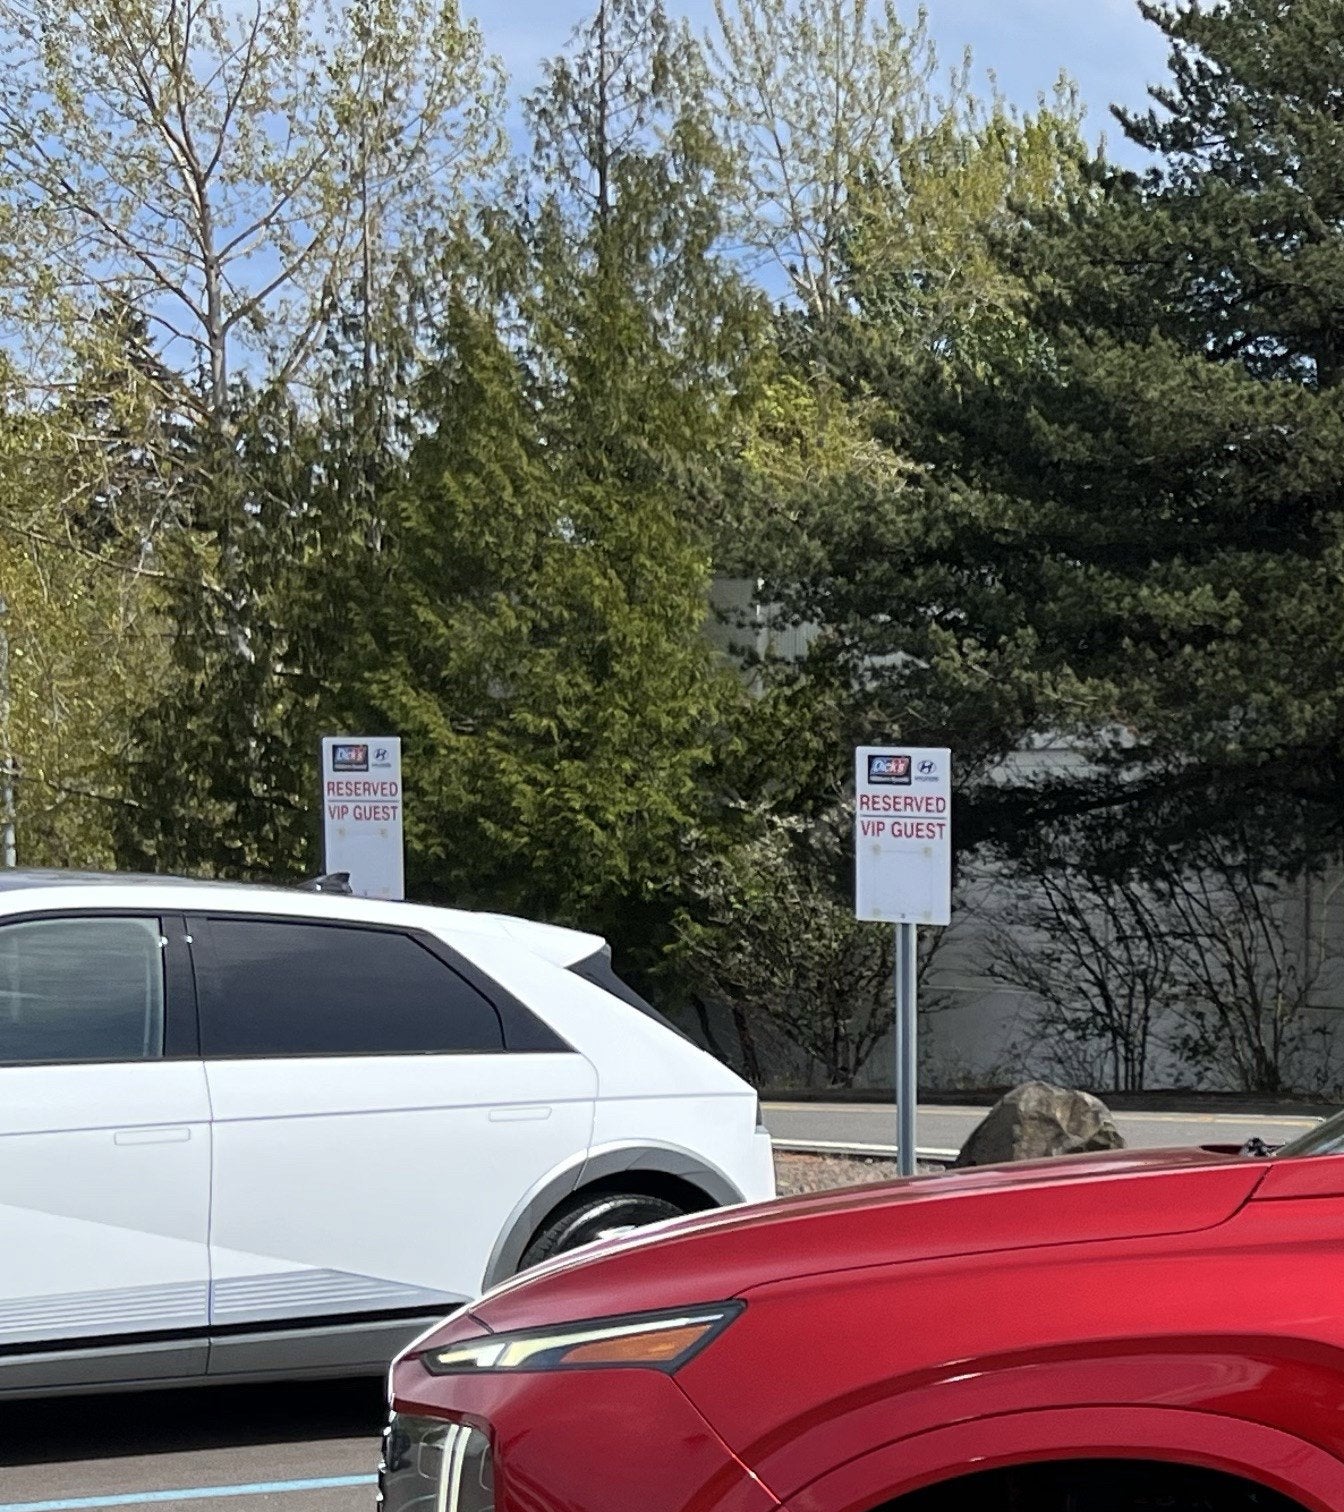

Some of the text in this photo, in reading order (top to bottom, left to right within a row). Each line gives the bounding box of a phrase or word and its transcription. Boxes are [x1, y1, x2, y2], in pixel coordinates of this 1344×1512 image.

[327, 781, 398, 797] RESERVED
[859, 794, 946, 813] RESERVED
[328, 805, 398, 821] VIP GUEST
[861, 820, 946, 840] VIP GUEST
